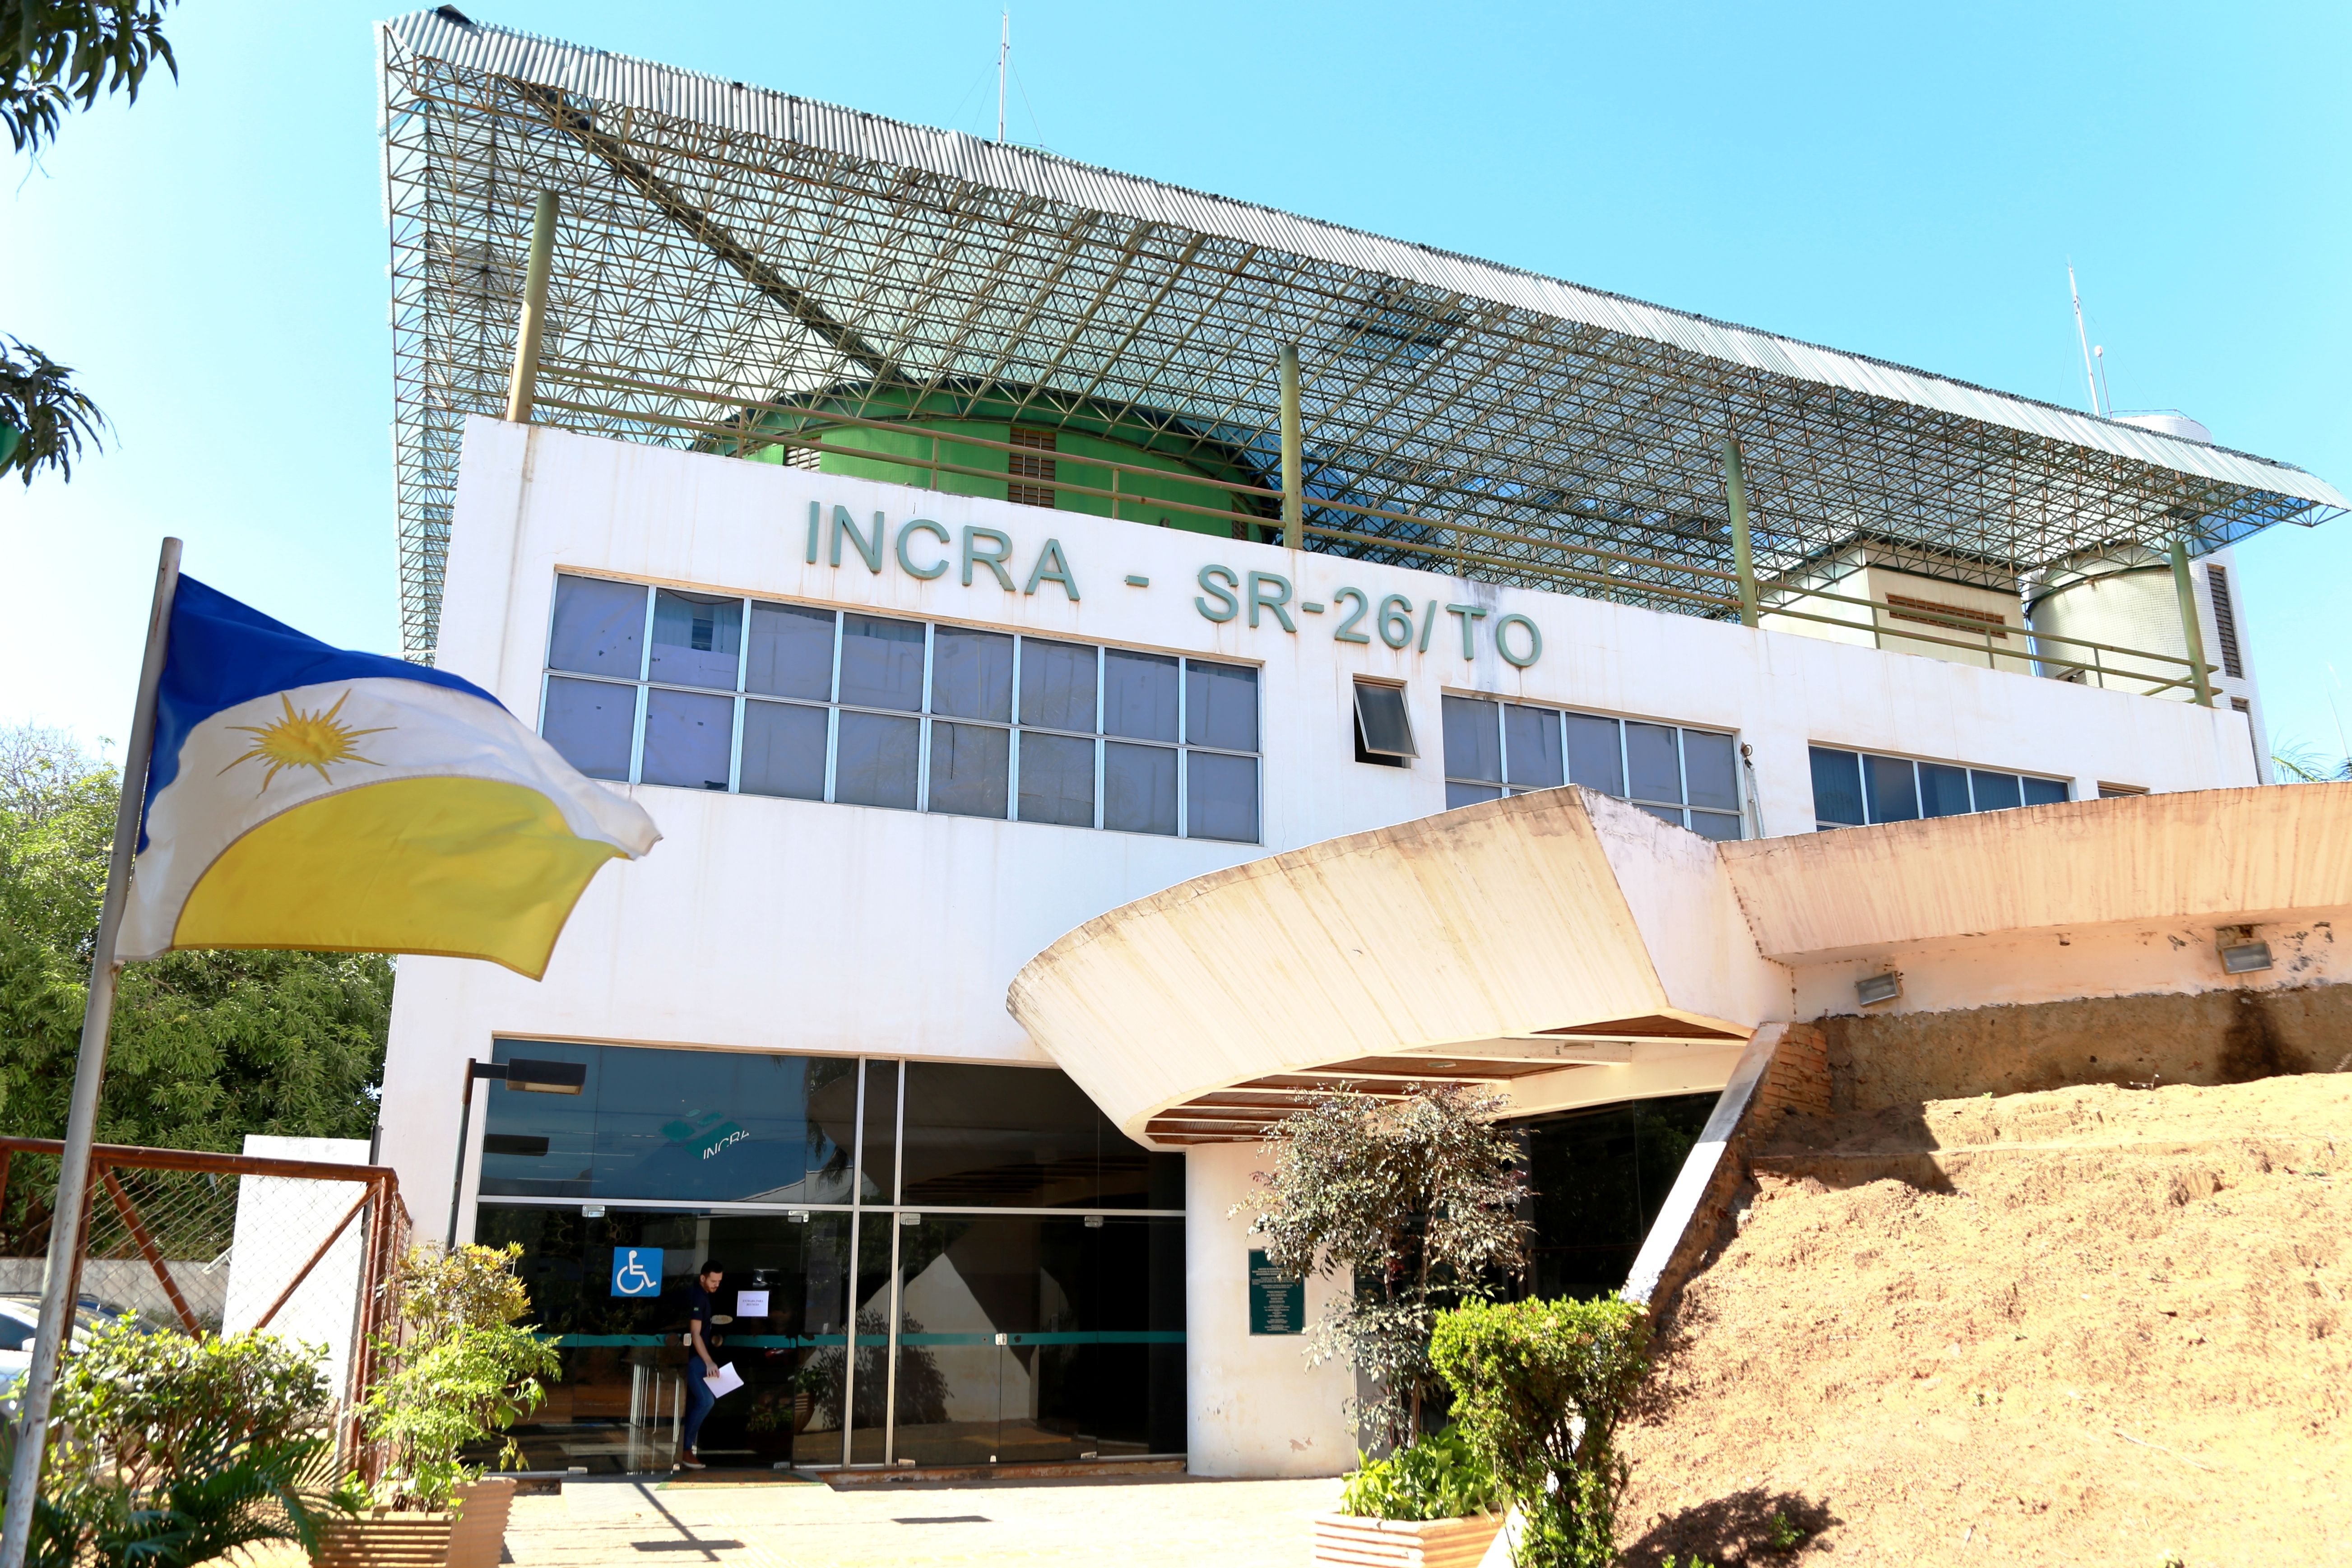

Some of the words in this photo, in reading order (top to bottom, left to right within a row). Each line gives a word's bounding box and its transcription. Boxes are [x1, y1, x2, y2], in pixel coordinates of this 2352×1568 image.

[806, 501, 1081, 601] INCRA
[1125, 575, 1149, 587] -
[1195, 564, 1543, 668] SR-26/TO
